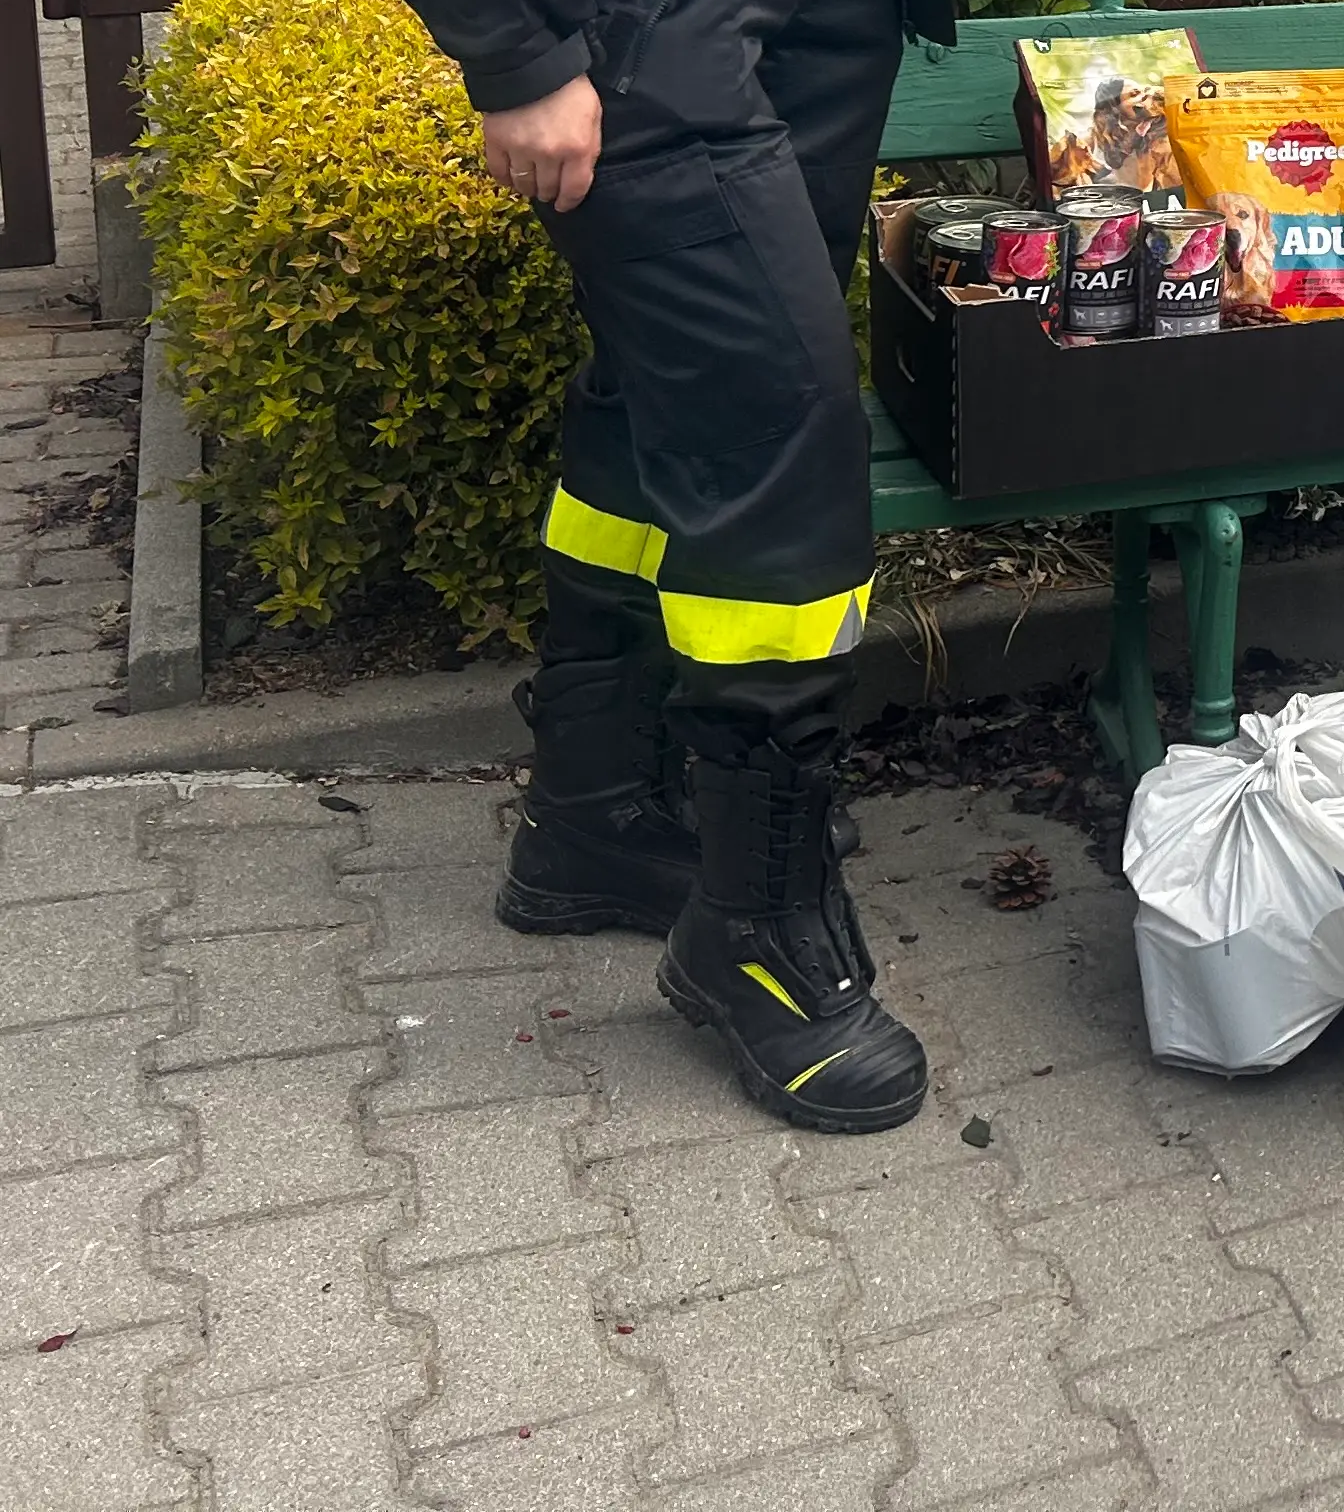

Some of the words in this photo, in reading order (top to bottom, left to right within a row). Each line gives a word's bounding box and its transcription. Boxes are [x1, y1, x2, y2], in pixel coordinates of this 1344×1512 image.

[1070, 268, 1135, 291] RAFI
[1157, 277, 1220, 301] RAFI
[1000, 284, 1051, 306] AFI
